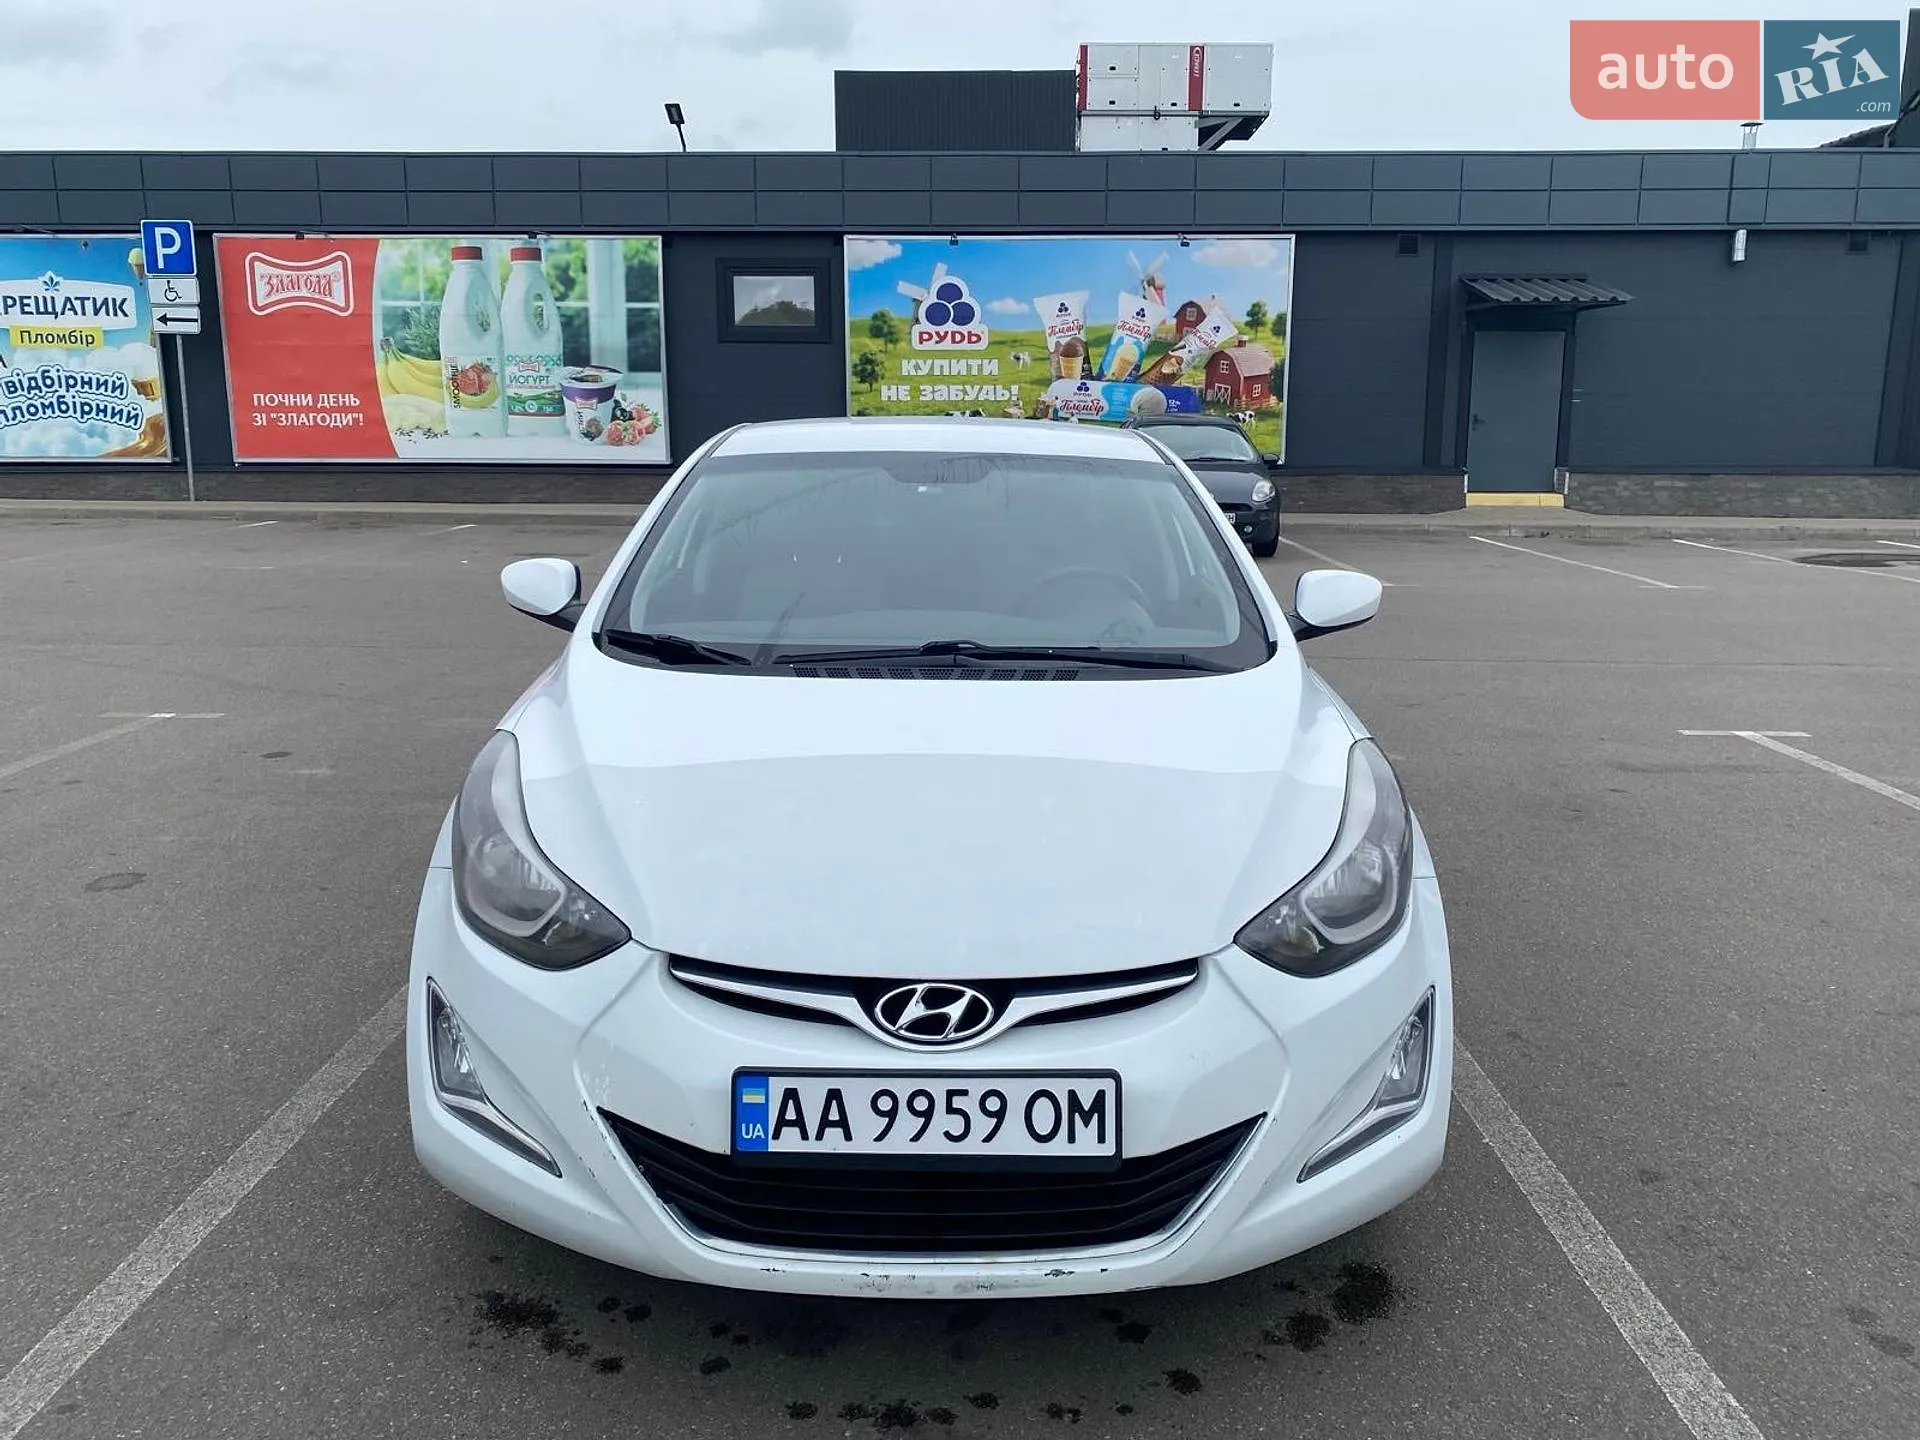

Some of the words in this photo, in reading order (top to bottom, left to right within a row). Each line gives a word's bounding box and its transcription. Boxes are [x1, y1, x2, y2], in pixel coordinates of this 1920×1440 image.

[154, 227, 182, 269] P
[0, 295, 129, 320] РЕЩАТИК
[19, 329, 95, 347] Пломбір
[918, 330, 982, 345] РУДЬ
[901, 358, 999, 376] КУПИТИ
[4, 368, 124, 396] відбірний
[252, 393, 313, 407] ПОЧНИ
[317, 393, 360, 409] ДЕНЬ
[880, 384, 911, 401] НЕ
[252, 412, 267, 426] ЗІ
[270, 412, 364, 428] "ЗЛАГОДИ"!
[771, 1087, 853, 1142] AA
[870, 1087, 1008, 1143] 9959
[1024, 1088, 1106, 1144] OM
[741, 1123, 765, 1139] UA
